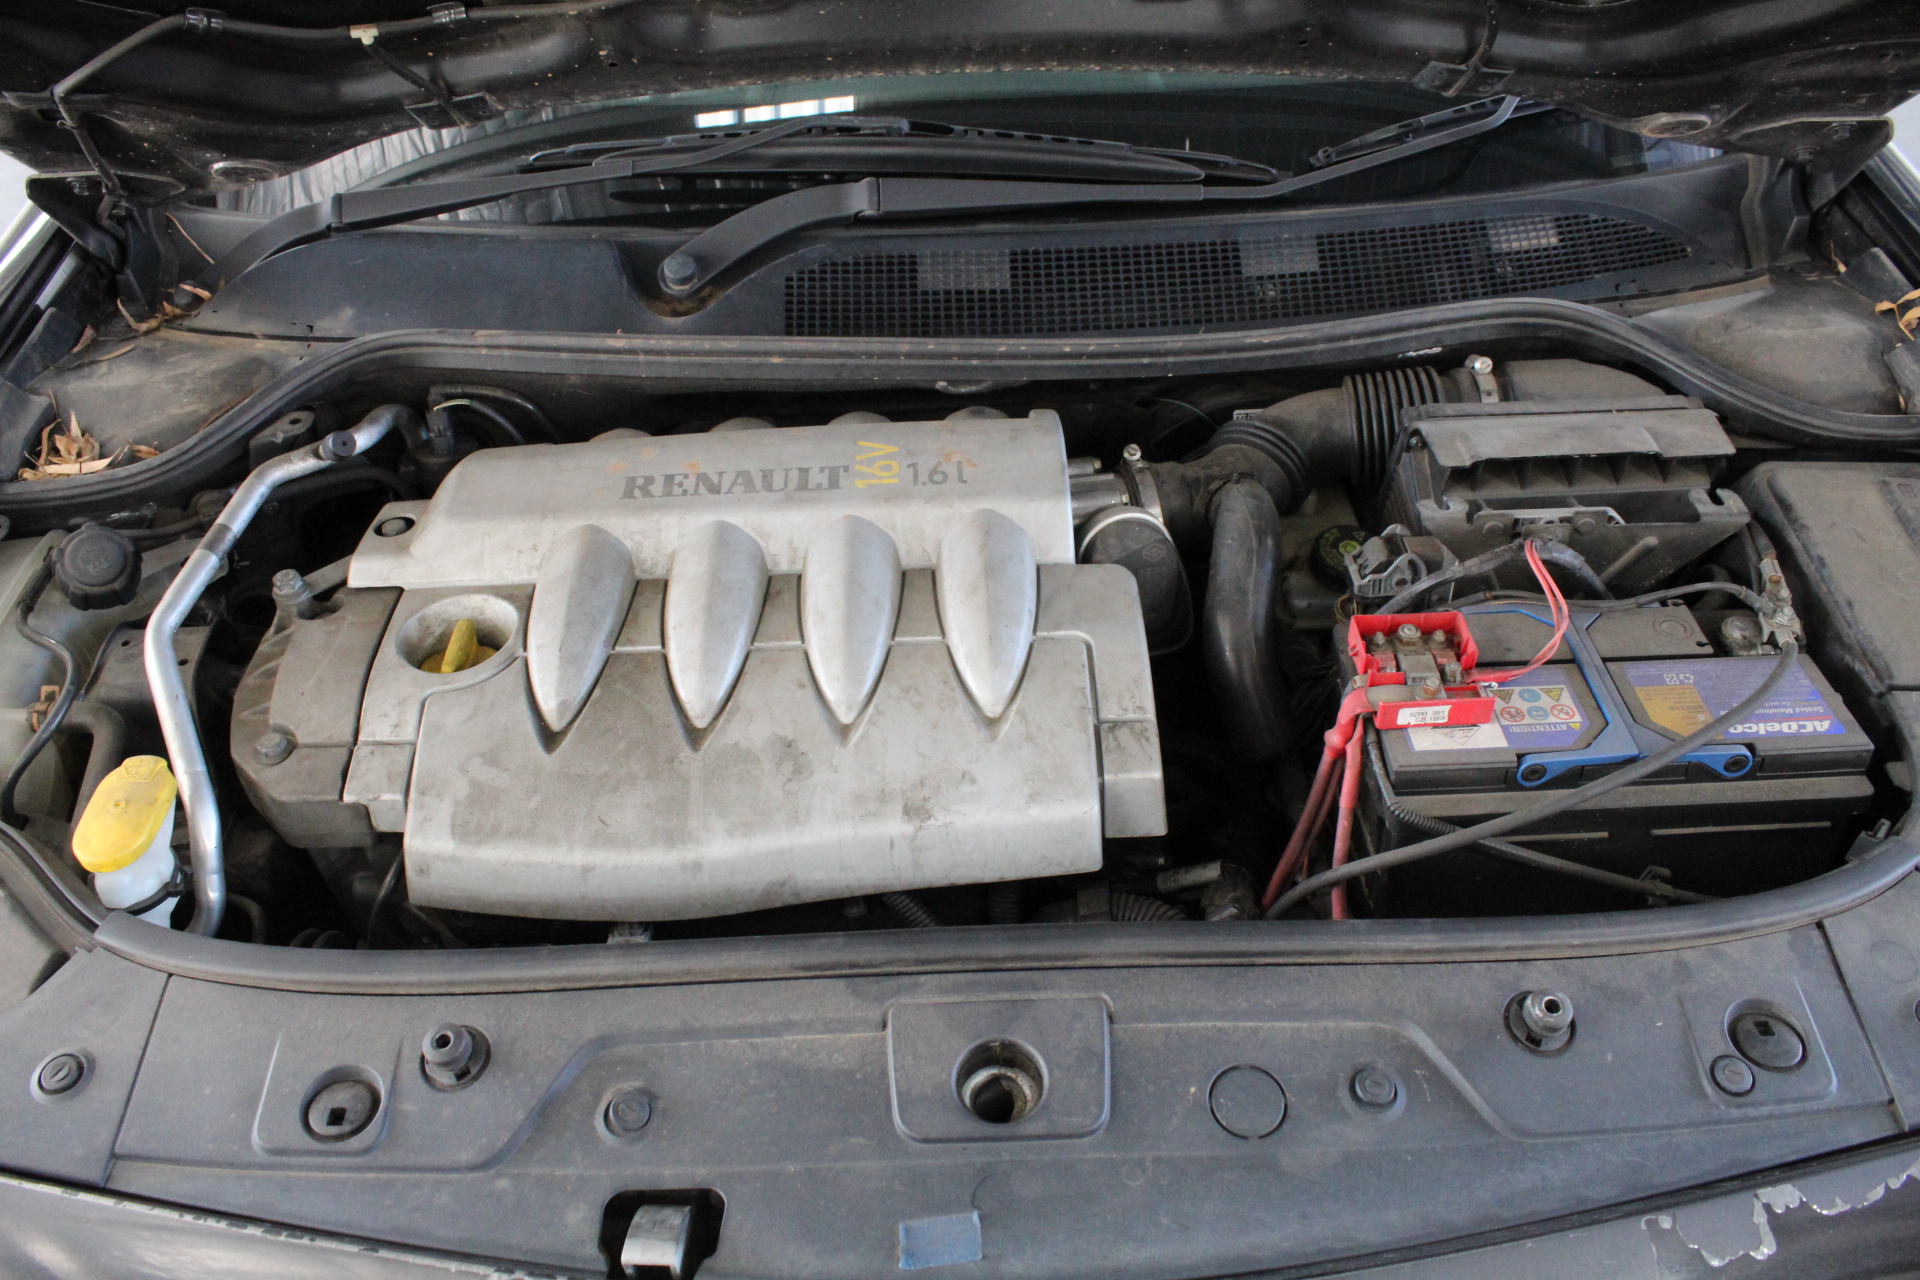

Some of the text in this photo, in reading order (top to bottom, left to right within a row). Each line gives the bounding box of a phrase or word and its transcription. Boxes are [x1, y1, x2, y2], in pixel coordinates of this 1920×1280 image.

[619, 464, 850, 500] RENAULT
[854, 440, 900, 489] 16V
[1795, 706, 1824, 714] Sealed
[1508, 723, 1567, 733] ATTENTION!
[1728, 720, 1831, 735] ACDelco
